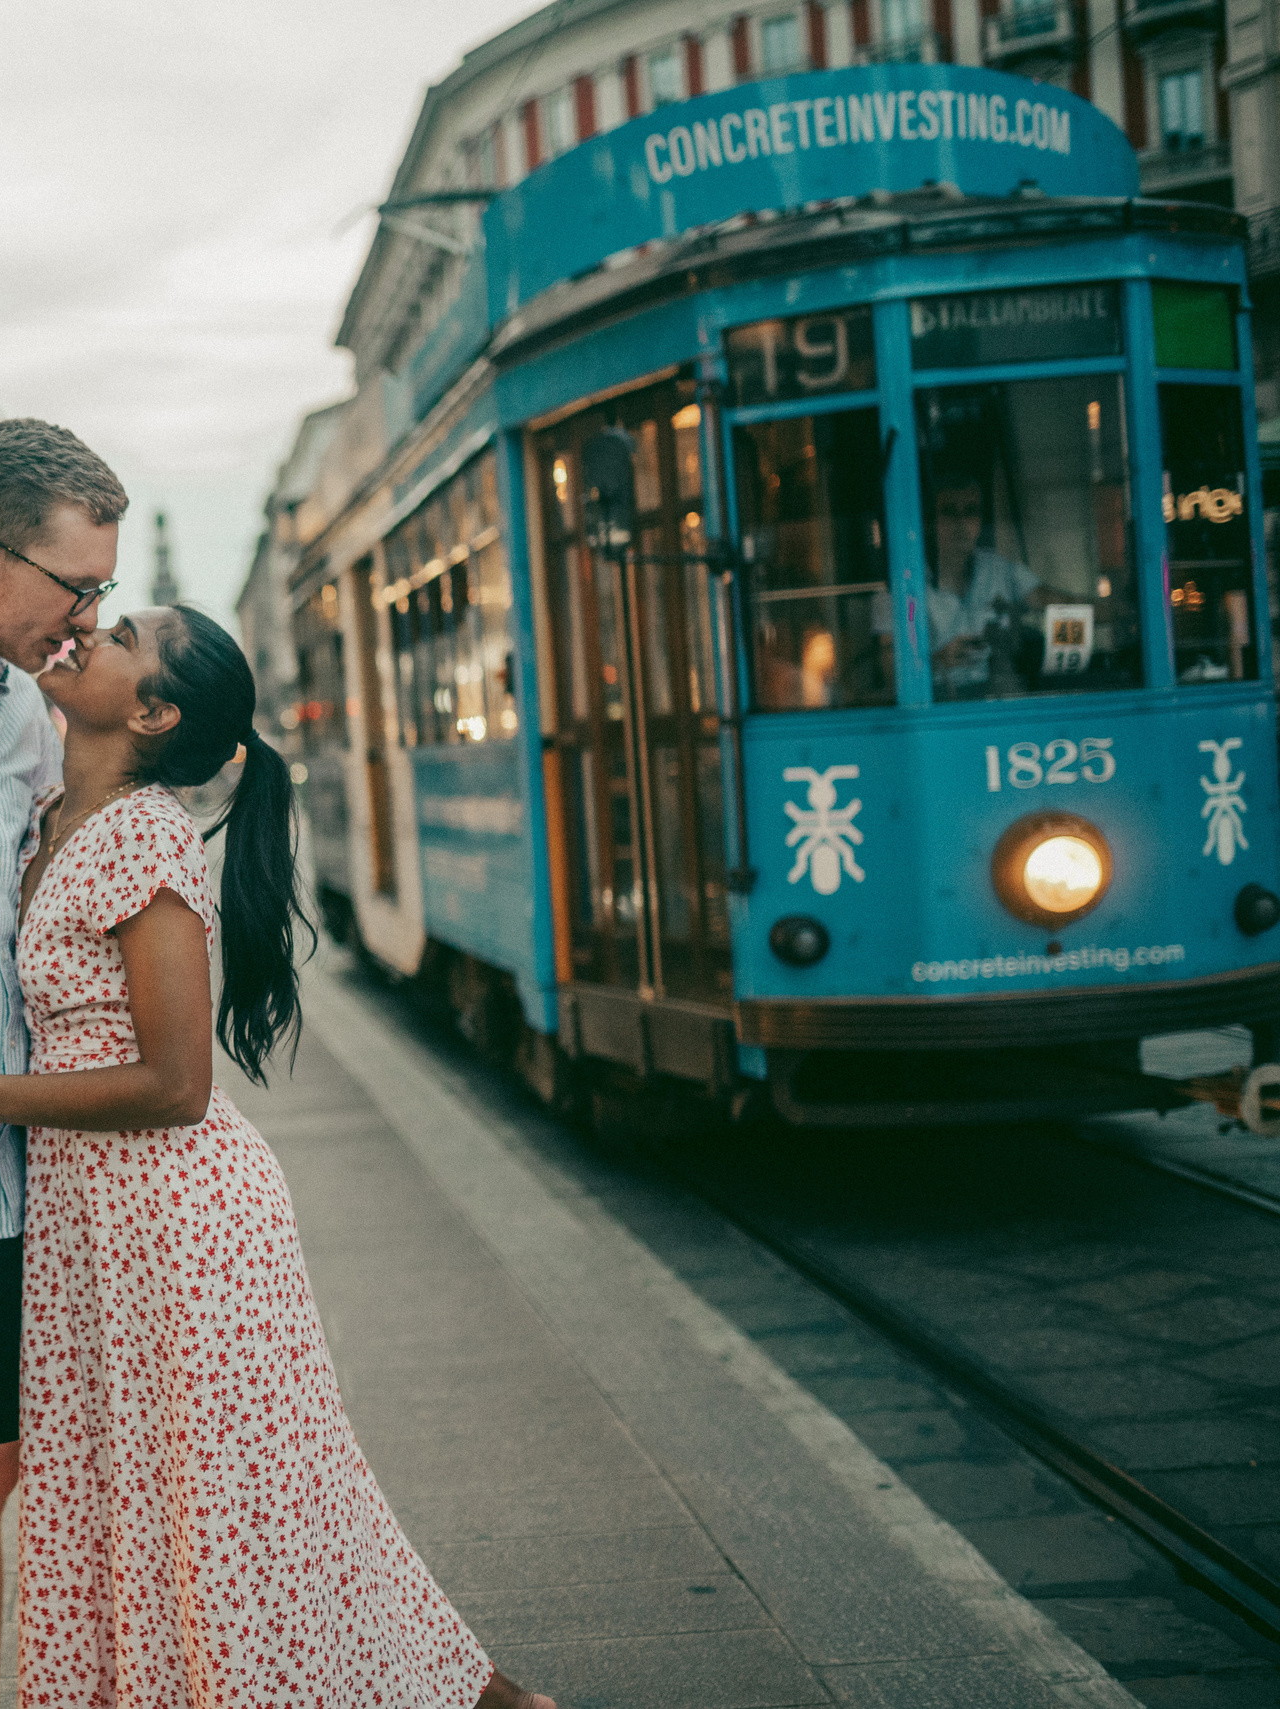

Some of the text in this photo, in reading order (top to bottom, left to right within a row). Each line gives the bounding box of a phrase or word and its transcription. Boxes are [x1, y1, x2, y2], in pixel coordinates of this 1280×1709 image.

[644, 90, 1072, 184] CONCRETEINVESTING.COM
[761, 312, 850, 396] 19
[985, 737, 1116, 792] 1825
[911, 943, 1186, 983] concreteinvesting.com
